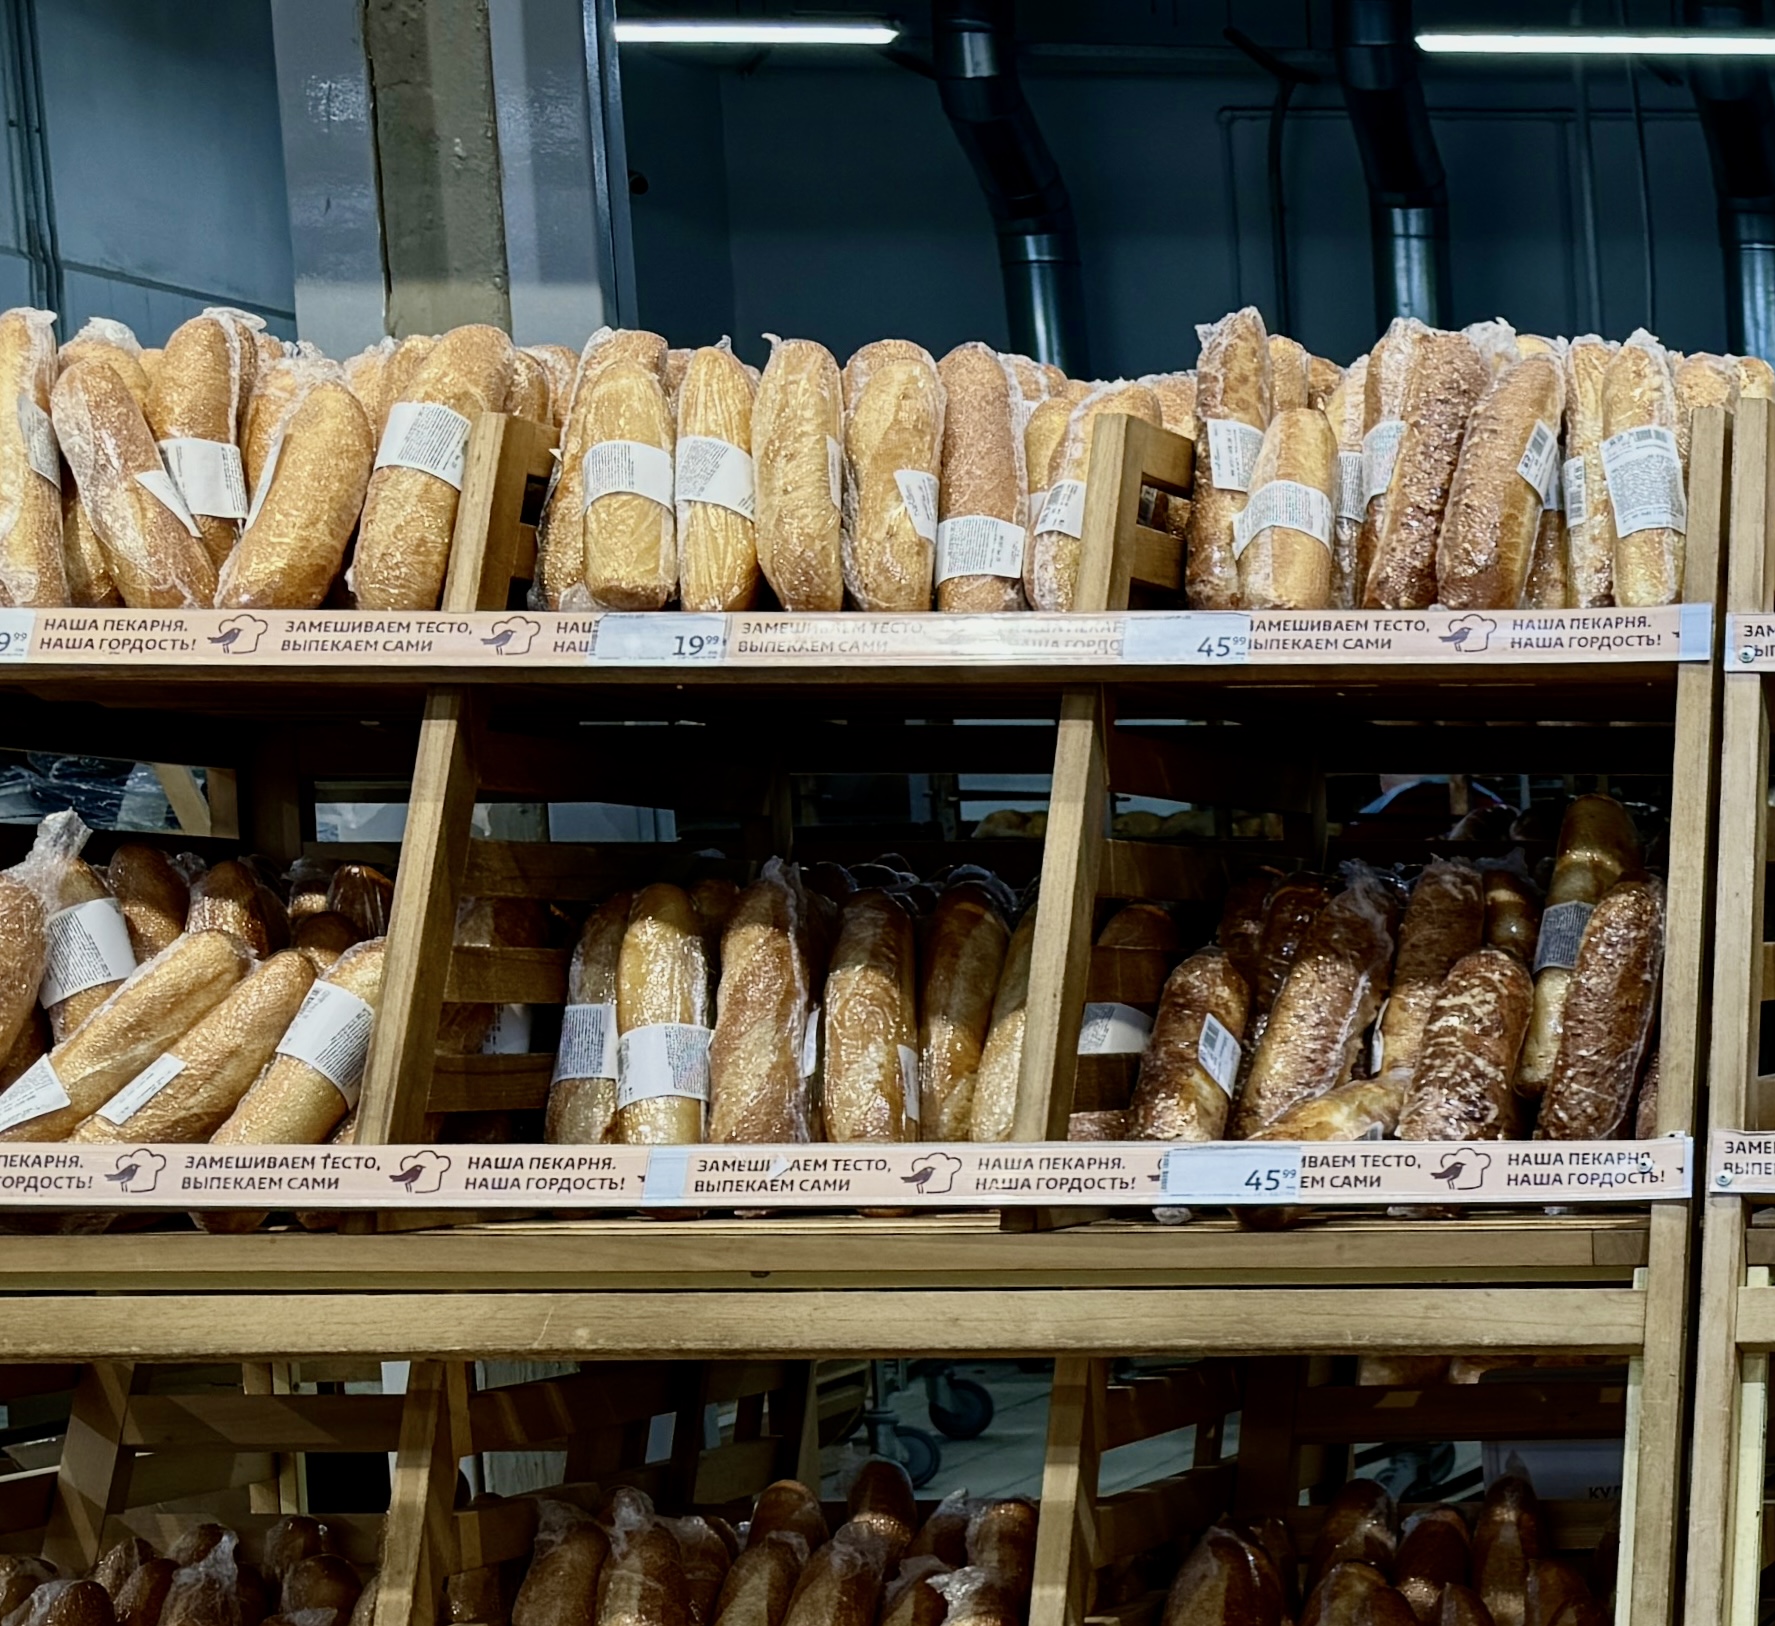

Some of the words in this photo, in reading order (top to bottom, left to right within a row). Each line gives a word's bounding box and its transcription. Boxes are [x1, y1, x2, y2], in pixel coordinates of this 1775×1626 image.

[44, 619, 98, 630] НАША
[104, 620, 187, 631] ПЕКАРНЯ.
[285, 621, 411, 633] ЗАМЕШИВАЕМ
[416, 622, 472, 635] ТЕСТО,
[1513, 619, 1565, 630] НАША
[1570, 616, 1651, 629] ПЕКАРНЯ.
[40, 638, 94, 649] НАША
[99, 638, 196, 654] ГОРДОСТЬ!
[281, 640, 378, 651] ВЫПЕКАЕМ
[383, 640, 432, 651] САМИ
[1511, 637, 1564, 648] НАША
[1569, 634, 1660, 650] ГОРДОСТЬ!
[185, 1156, 315, 1169] ЗАМЕШИВАЕМ
[321, 1153, 380, 1171] ТЕСТО,
[468, 1157, 523, 1169] НАША
[529, 1157, 616, 1170] ПЕКАРНЯ.
[832, 1159, 890, 1172] ТЕСТО,
[978, 1158, 1033, 1170] НАША
[1039, 1158, 1125, 1170] ПЕКАРНЯ.
[1508, 1153, 1563, 1165] НАША
[182, 1177, 282, 1189] ВЫПЕКАЕМ
[287, 1178, 339, 1189] САМИ
[465, 1178, 520, 1189] НАША
[526, 1177, 625, 1193] ГОРДОСТЬ!
[695, 1179, 794, 1192] ВЫПЕКАЕМ
[799, 1179, 850, 1191] САМИ
[976, 1178, 1031, 1190] НАША
[1037, 1177, 1135, 1193] ГОРДОСТЬ!
[1507, 1173, 1563, 1186] НАША
[1568, 1172, 1664, 1188] ГОРДОСТЬ!
